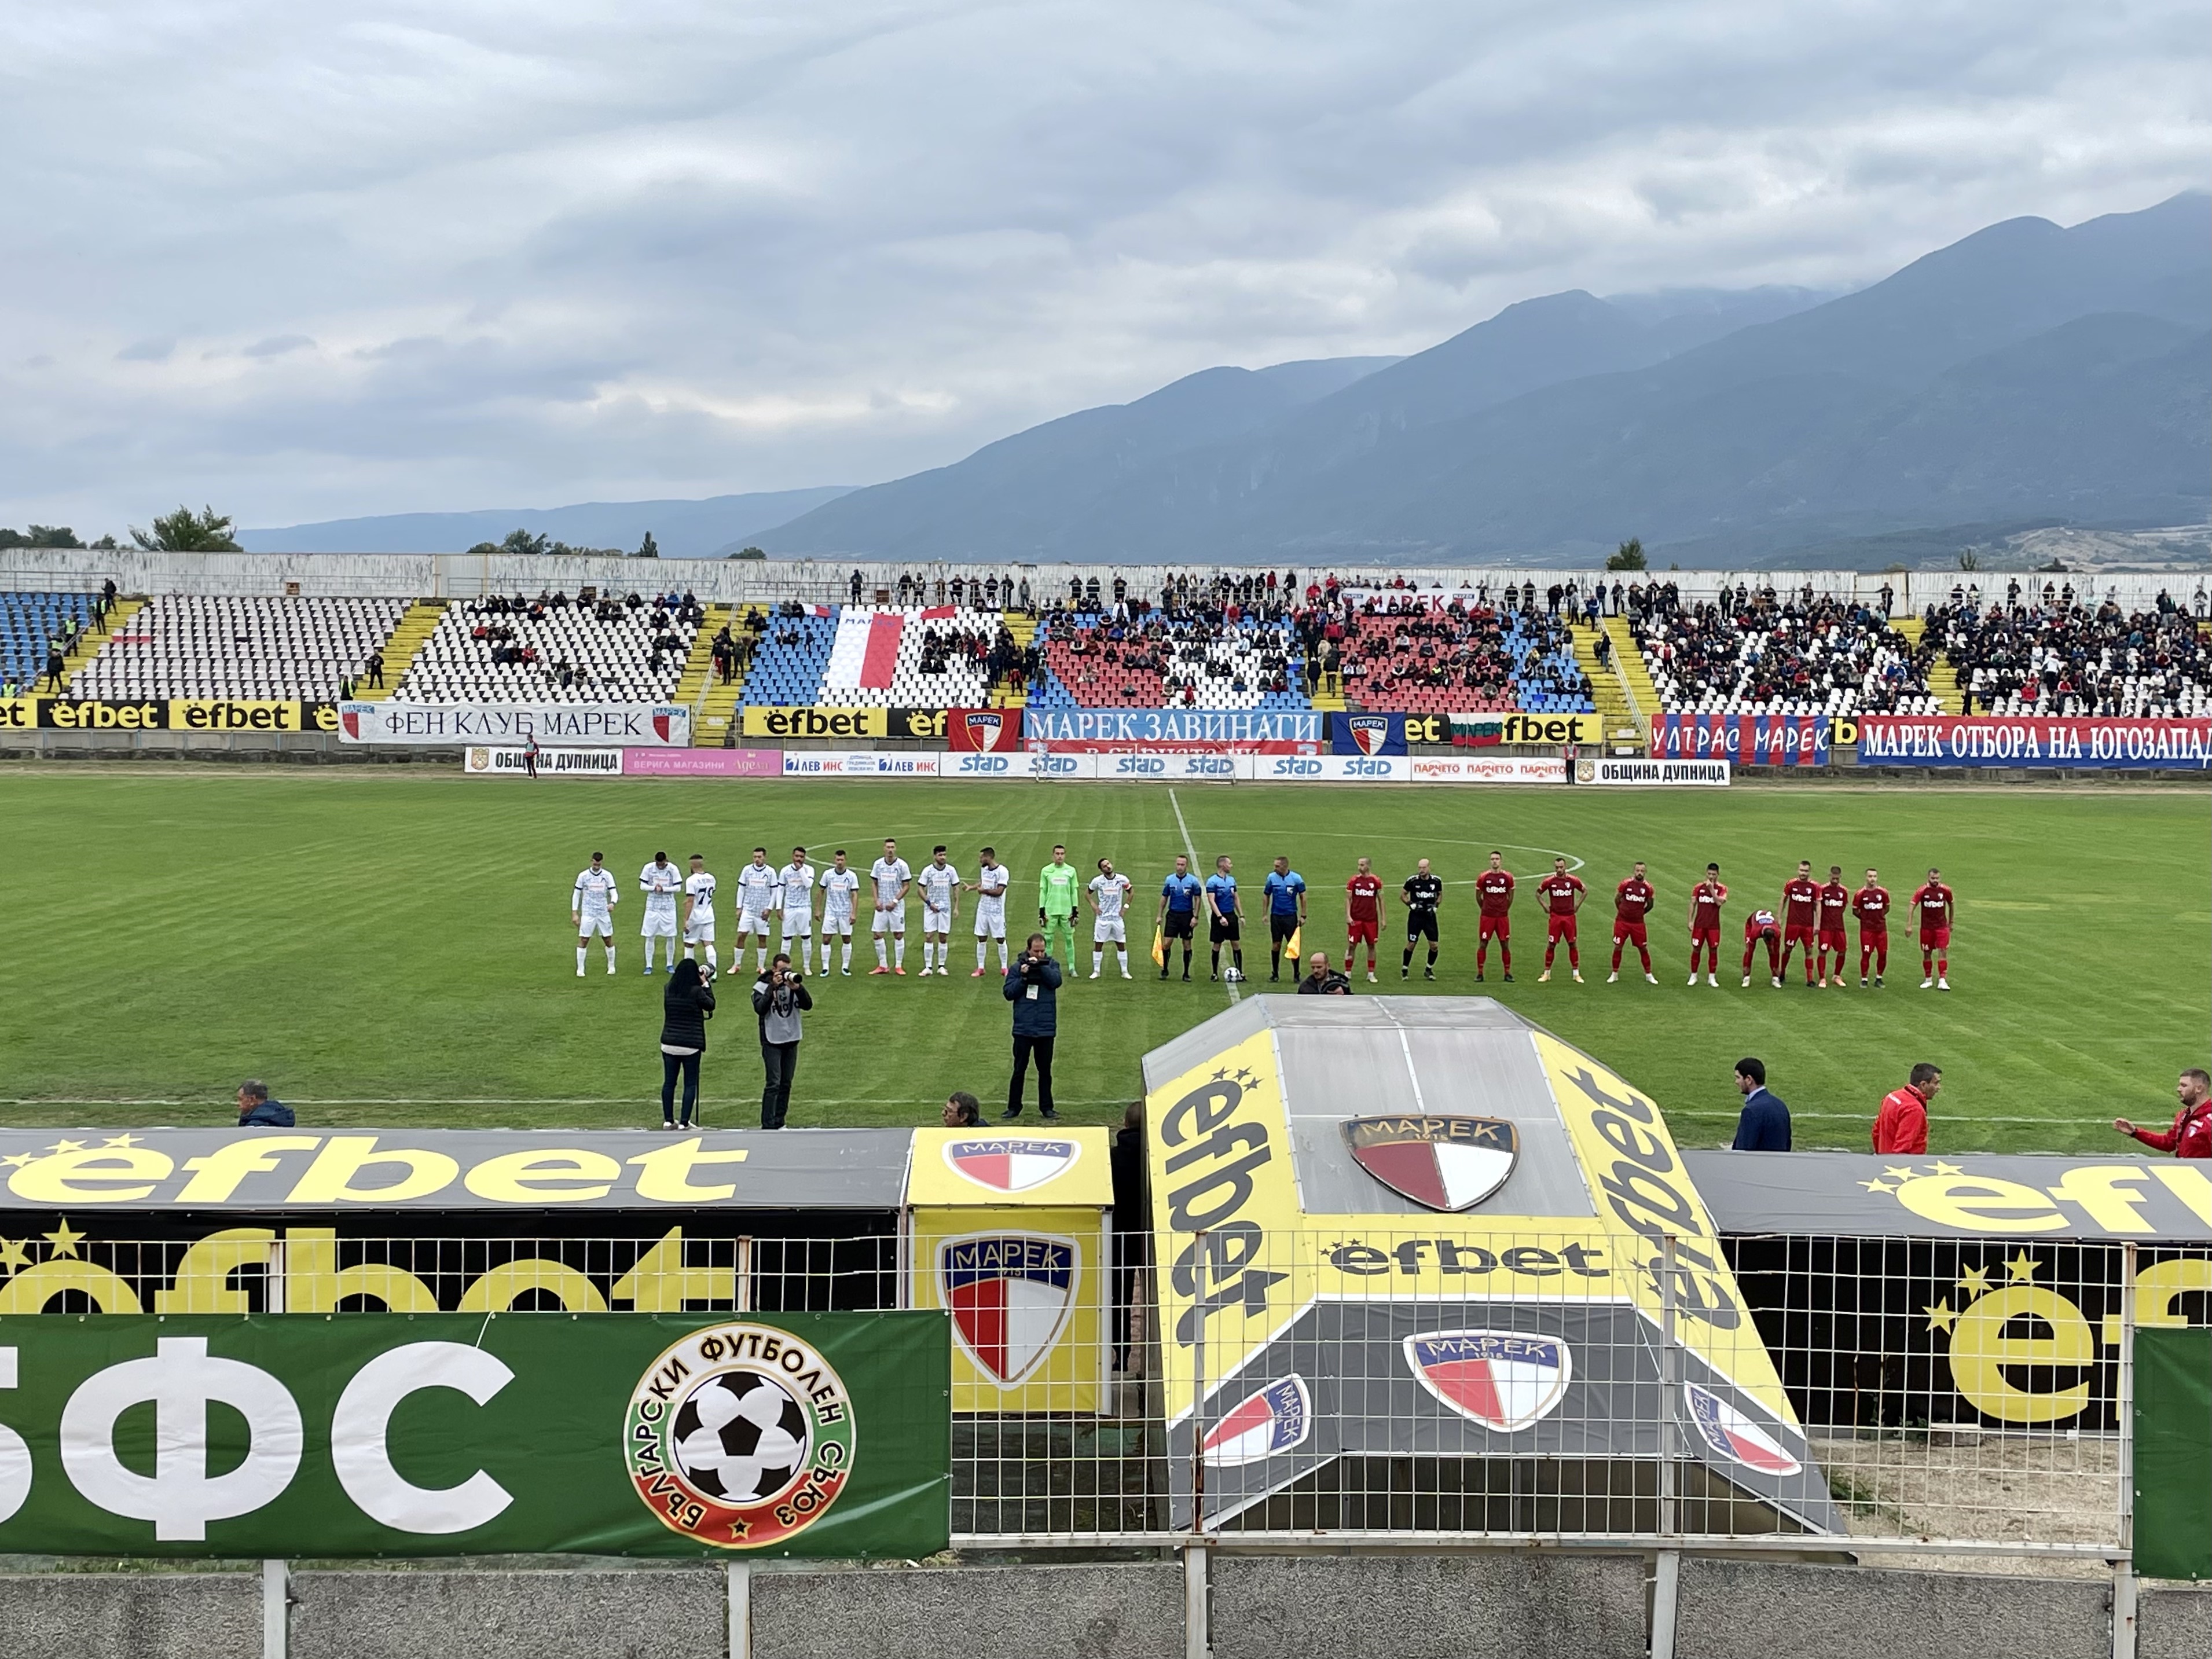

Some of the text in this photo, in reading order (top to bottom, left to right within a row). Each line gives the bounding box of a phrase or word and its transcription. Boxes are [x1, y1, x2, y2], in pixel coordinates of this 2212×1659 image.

[53, 701, 158, 728] efbet
[186, 703, 289, 729] efbet
[386, 711, 642, 736] ФЕН КЛУБ МАРЕК
[768, 709, 868, 735] efbet
[1029, 713, 1318, 742] МАРЕК ЗАВИНАГИ
[1652, 726, 1830, 753] УЛТРАС МАРЕК
[1865, 724, 1943, 758] МАРЕК
[1951, 725, 2040, 759] ОТБОРА
[2049, 726, 2082, 759] НА
[495, 752, 618, 771] ОБЩНА ДУПНИЦА
[1601, 764, 1726, 782] ОБЩИНА ДУПНИЦА
[1359, 1118, 1501, 1141] МАРЕК
[962, 1142, 1064, 1153] МАРЕК
[8, 1136, 749, 1203] efbet
[1560, 1066, 1741, 1330] efbet
[1161, 1080, 1290, 1348] efbet
[956, 1243, 1064, 1273] МАРЕК
[1330, 1239, 1611, 1277] efbet
[1426, 1338, 1547, 1358] МАРЕК
[0, 1336, 515, 1541] ФС
[636, 1333, 844, 1529] БЪЛГАРСКИ ФУТБОЛЕН СЪЮЗ
